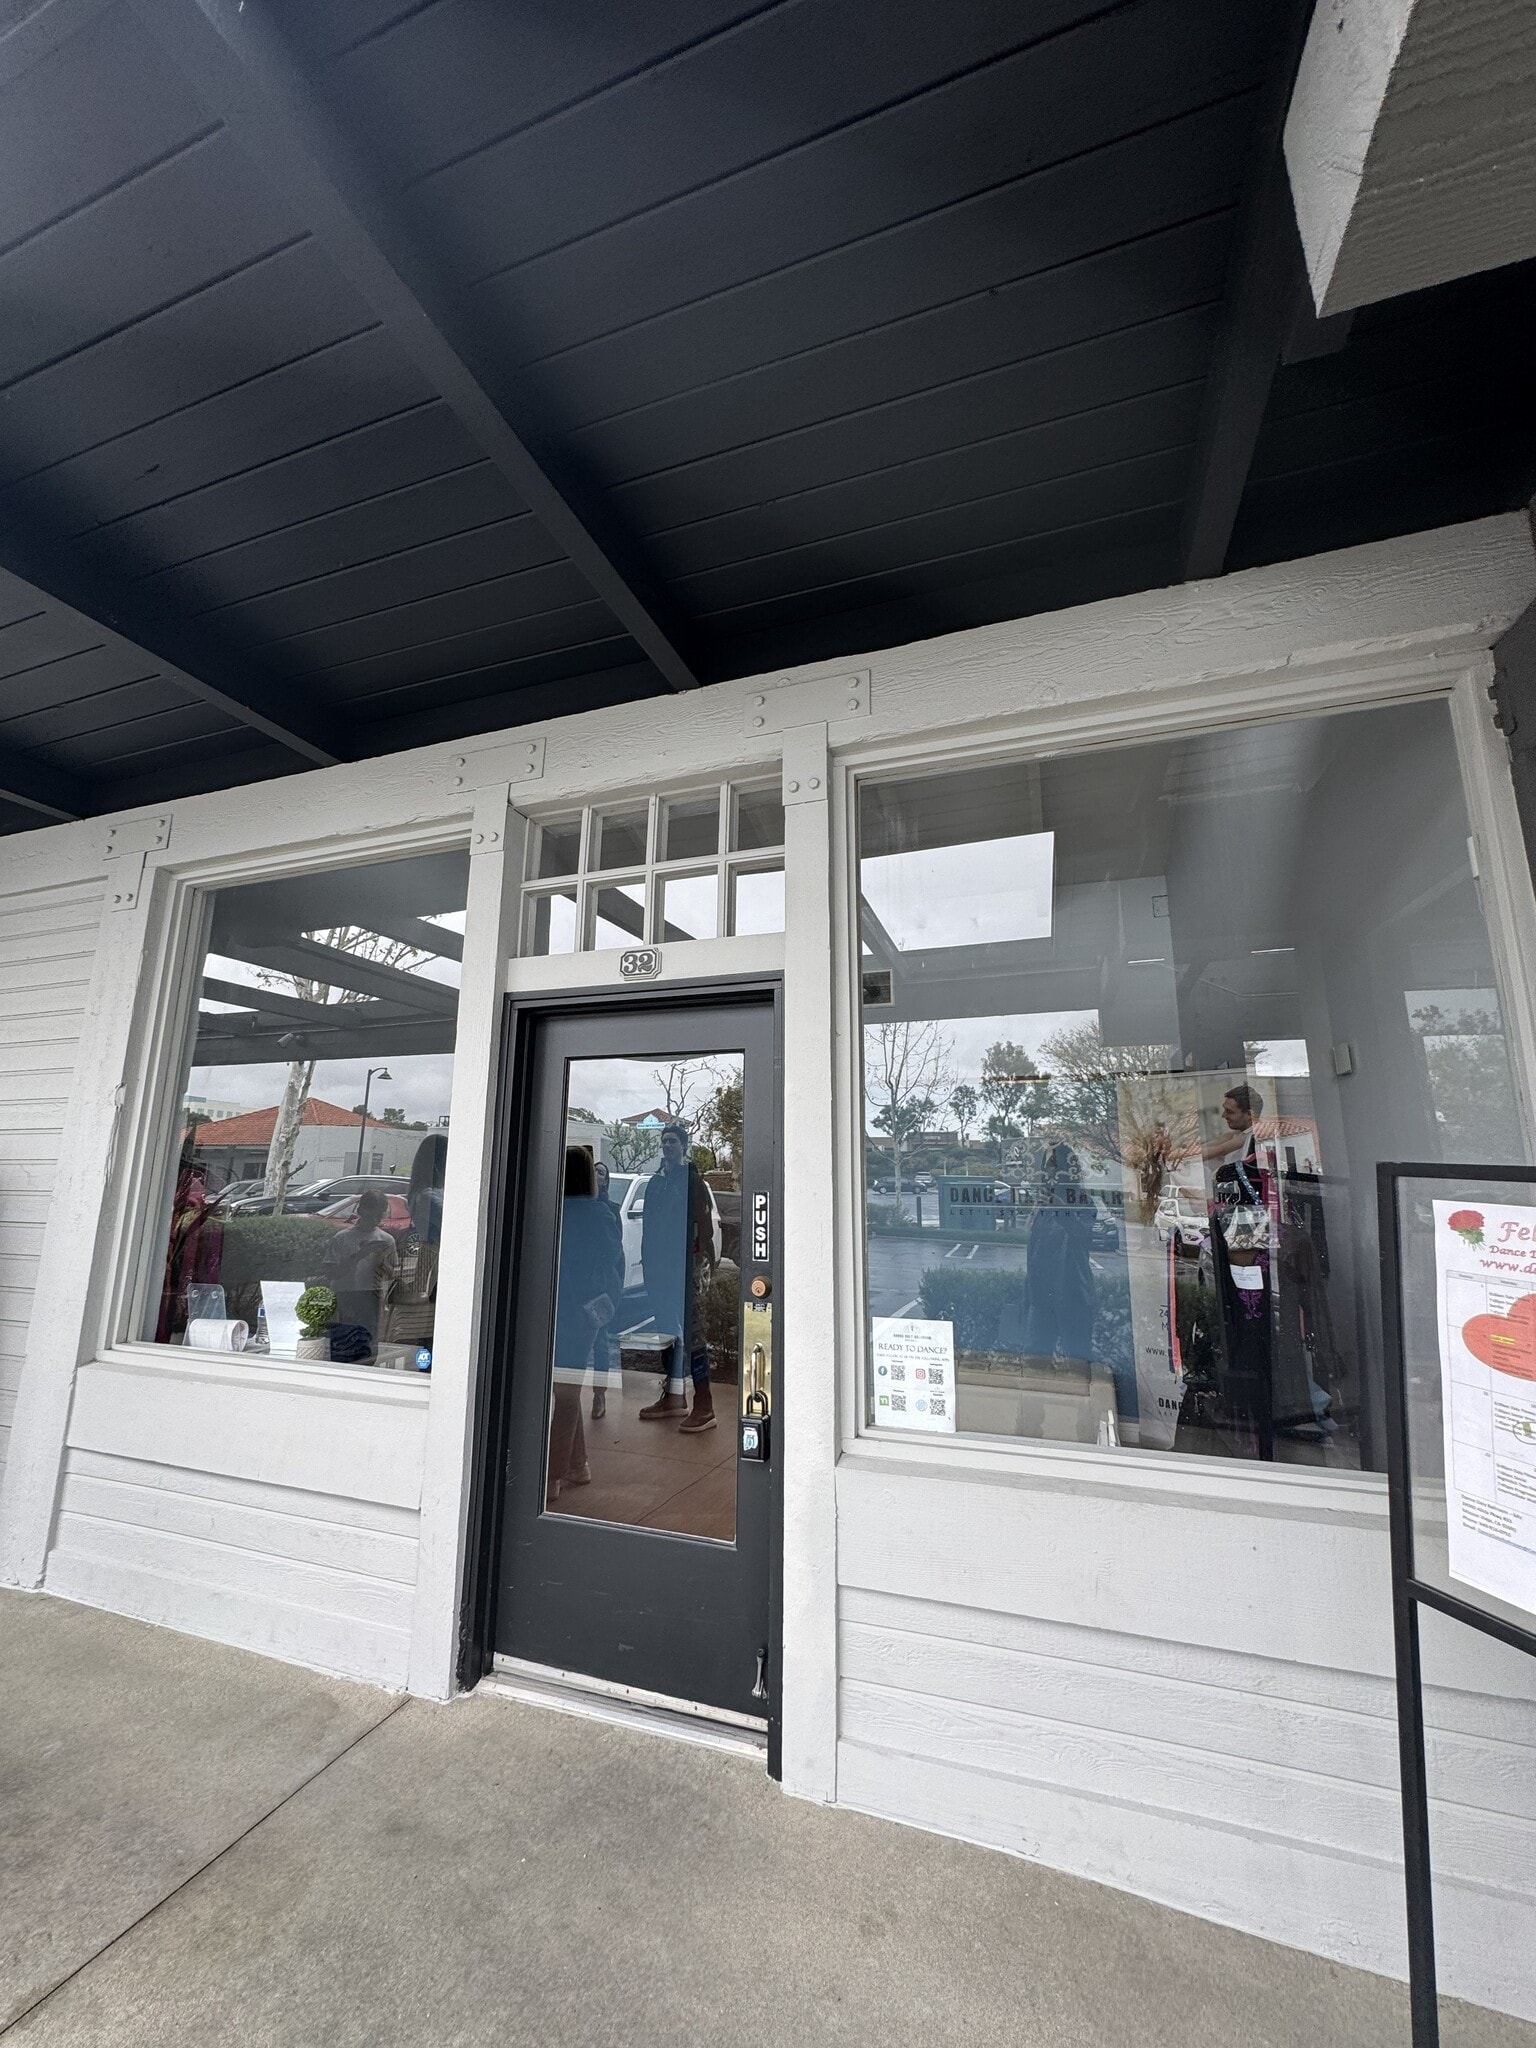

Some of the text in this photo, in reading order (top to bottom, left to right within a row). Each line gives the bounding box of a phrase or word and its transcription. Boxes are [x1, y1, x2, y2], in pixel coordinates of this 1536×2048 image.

[624, 953, 653, 973] 32
[755, 1194, 767, 1257] PUSH
[1489, 1245, 1526, 1257] Dance
[878, 1342, 948, 1354] READY TO DANCE?
